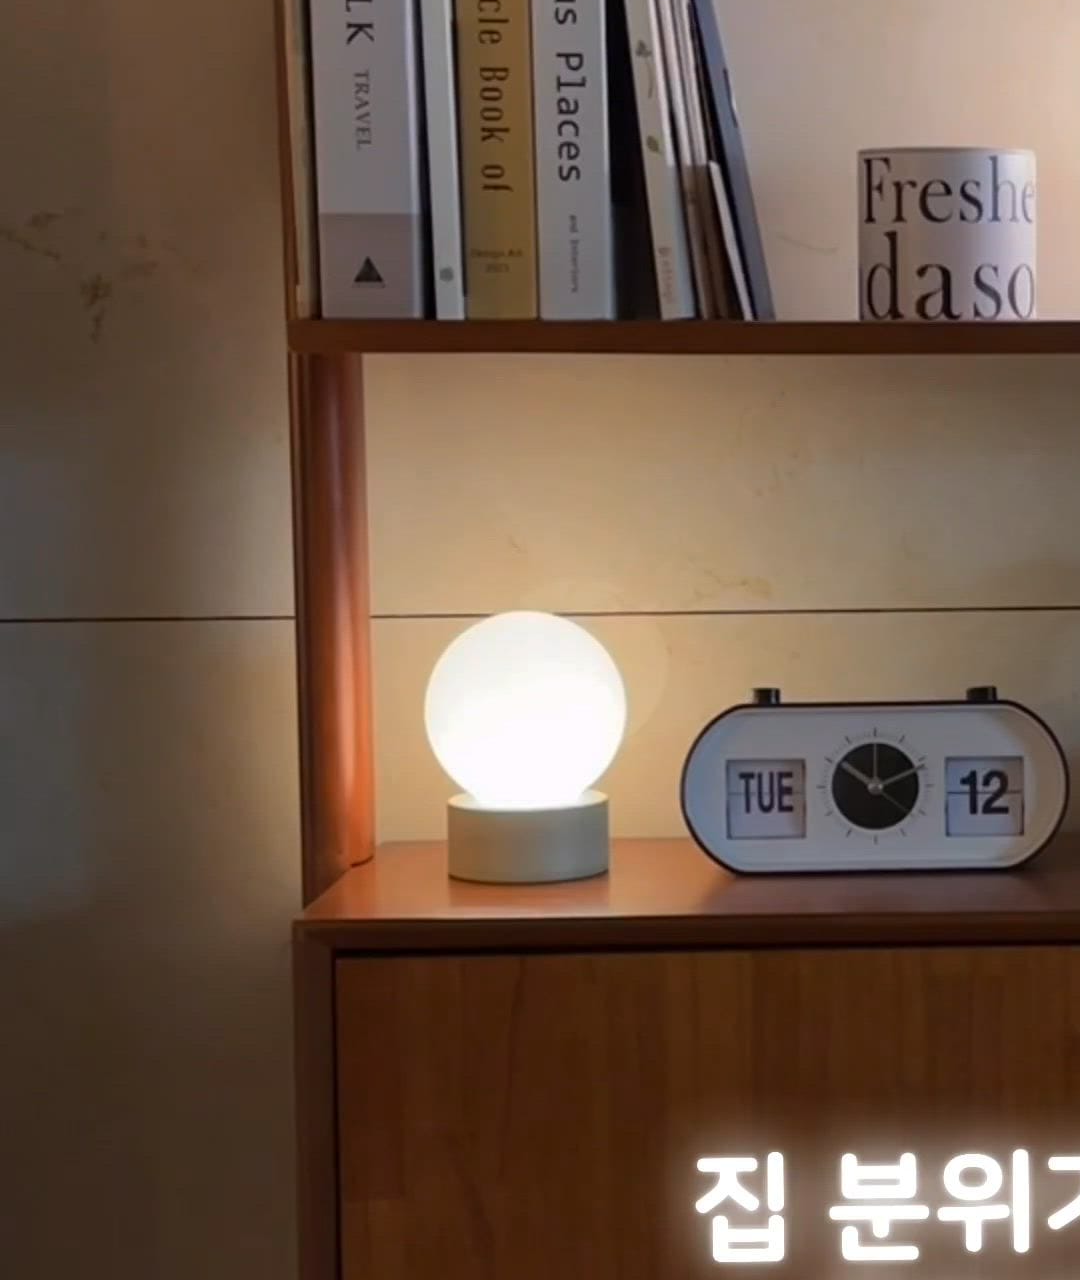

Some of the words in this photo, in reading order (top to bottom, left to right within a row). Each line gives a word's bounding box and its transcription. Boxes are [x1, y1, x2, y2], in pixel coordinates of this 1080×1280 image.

[353, 69, 373, 150] TRAVEL
[479, 66, 511, 143] Book
[555, 52, 587, 182] Places
[481, 164, 514, 193] of
[866, 230, 1035, 321] daso
[738, 771, 795, 814] TUE
[958, 769, 1010, 815] 12
